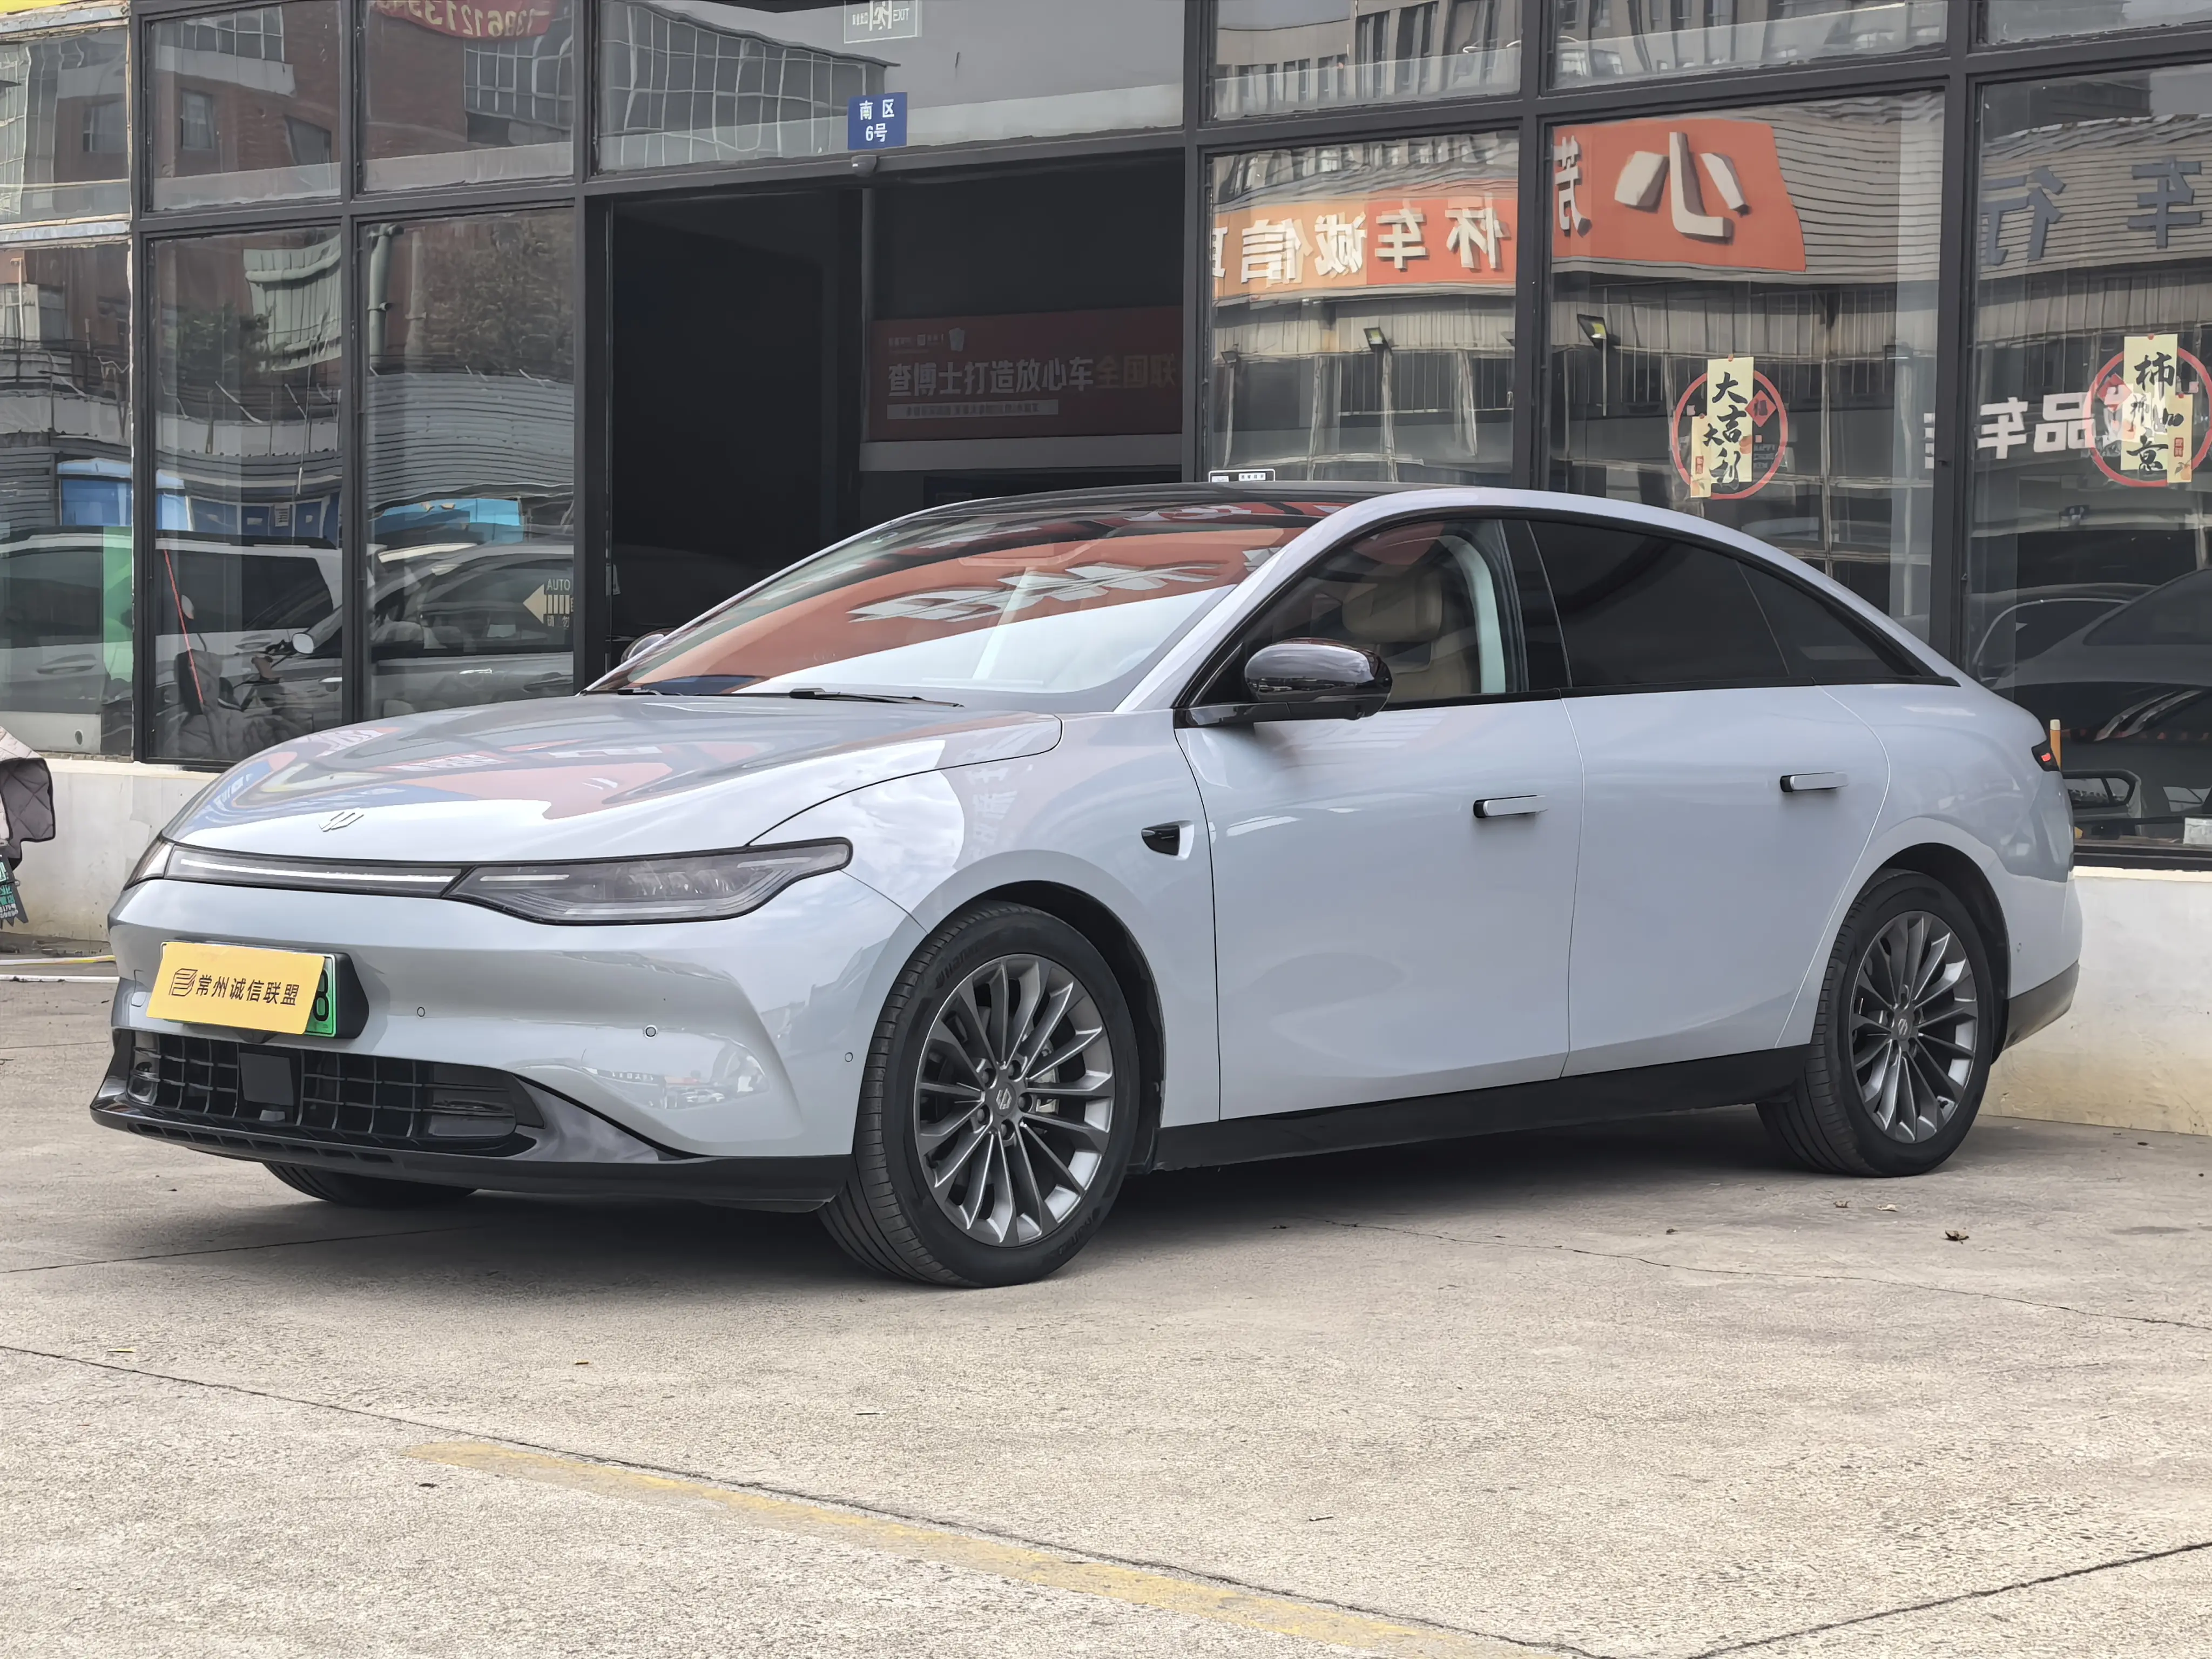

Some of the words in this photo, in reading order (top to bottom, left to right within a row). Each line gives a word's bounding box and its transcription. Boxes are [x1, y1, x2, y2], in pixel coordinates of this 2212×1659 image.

[893, 8, 910, 22] EXIT
[858, 98, 895, 121] 南区
[865, 123, 888, 143] 6号
[547, 578, 570, 591] AUTO
[195, 974, 300, 1006] 常州诚信联盟
